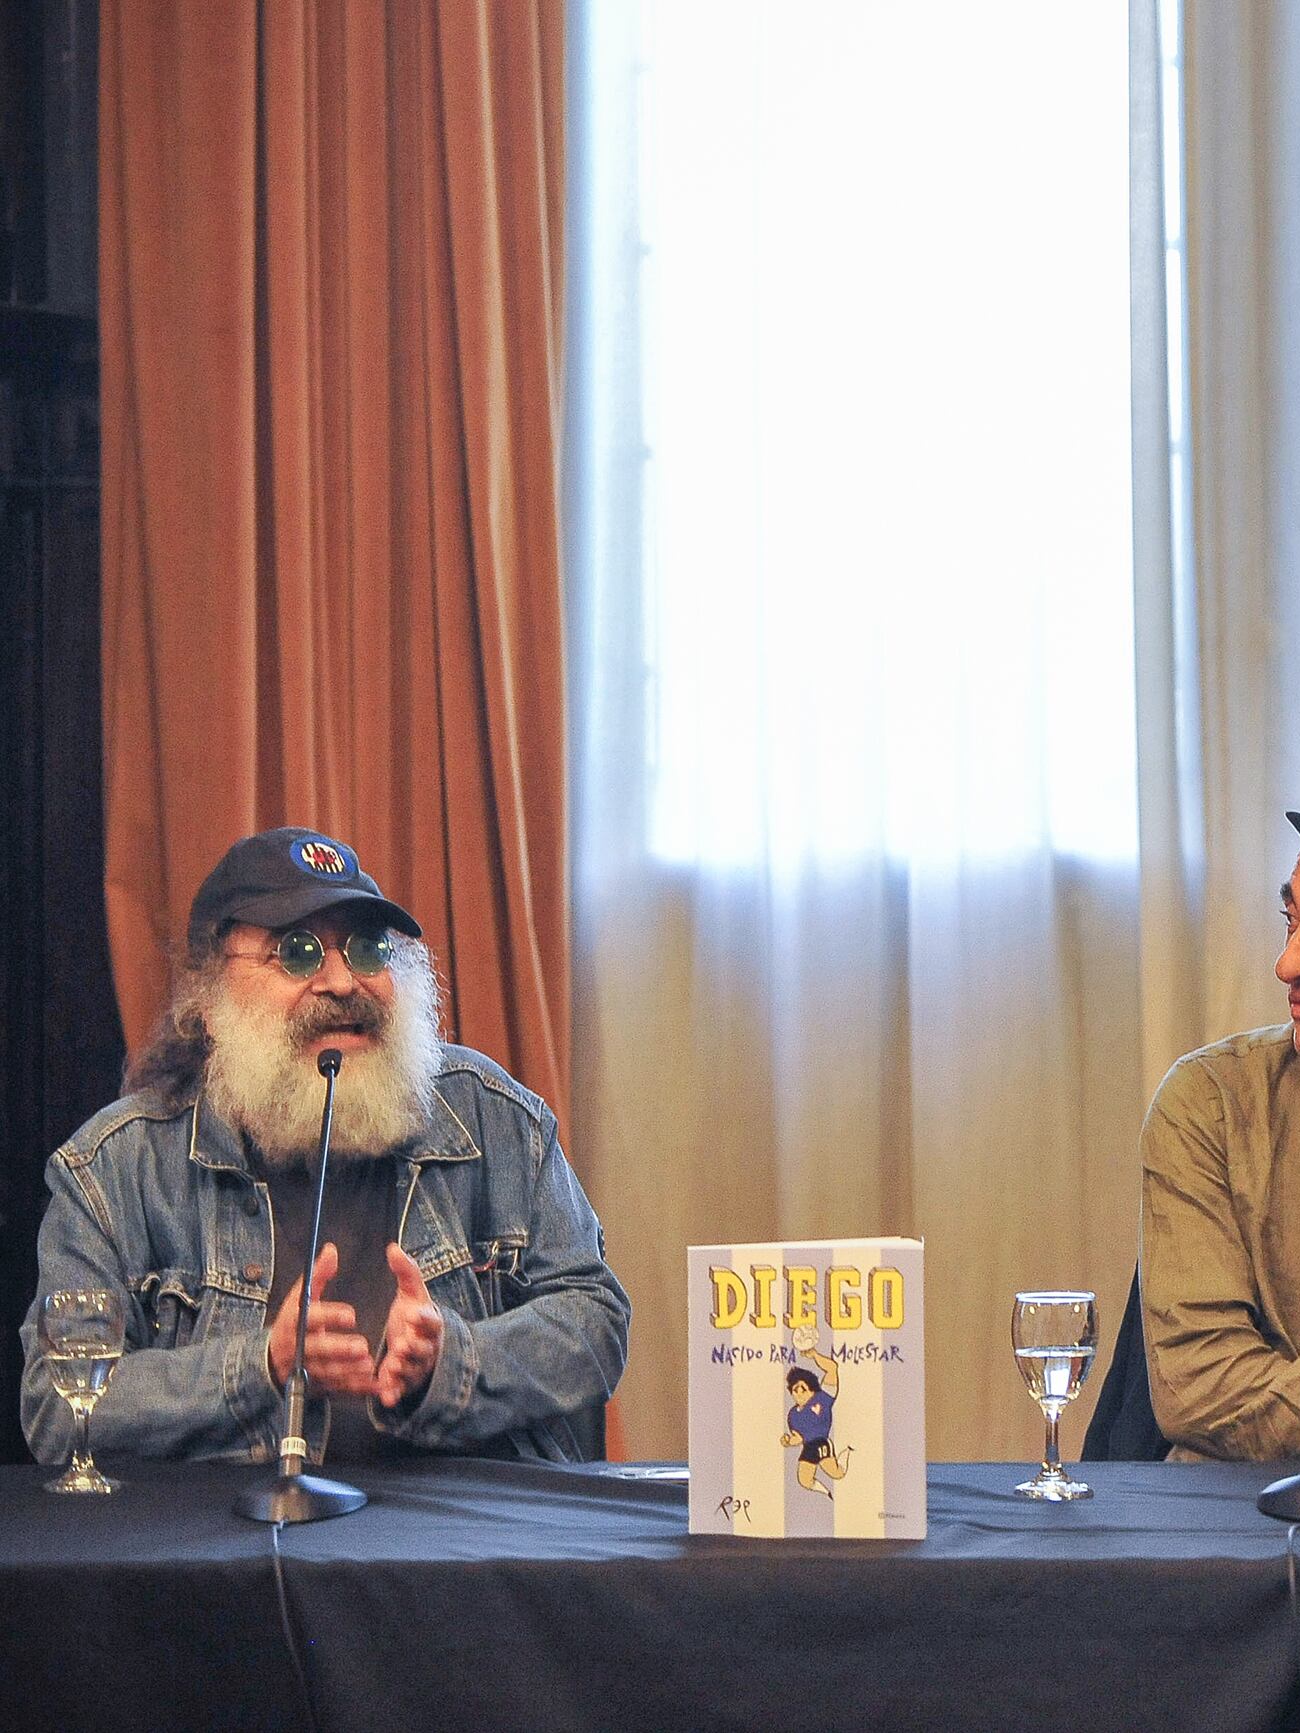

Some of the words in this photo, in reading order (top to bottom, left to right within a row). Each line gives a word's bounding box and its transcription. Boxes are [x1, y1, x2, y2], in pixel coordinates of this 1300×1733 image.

[709, 1264, 904, 1330] DIEGO
[711, 1343, 763, 1366] NACIDO
[769, 1344, 797, 1363] PARA
[830, 1341, 904, 1365] MOLESTAR
